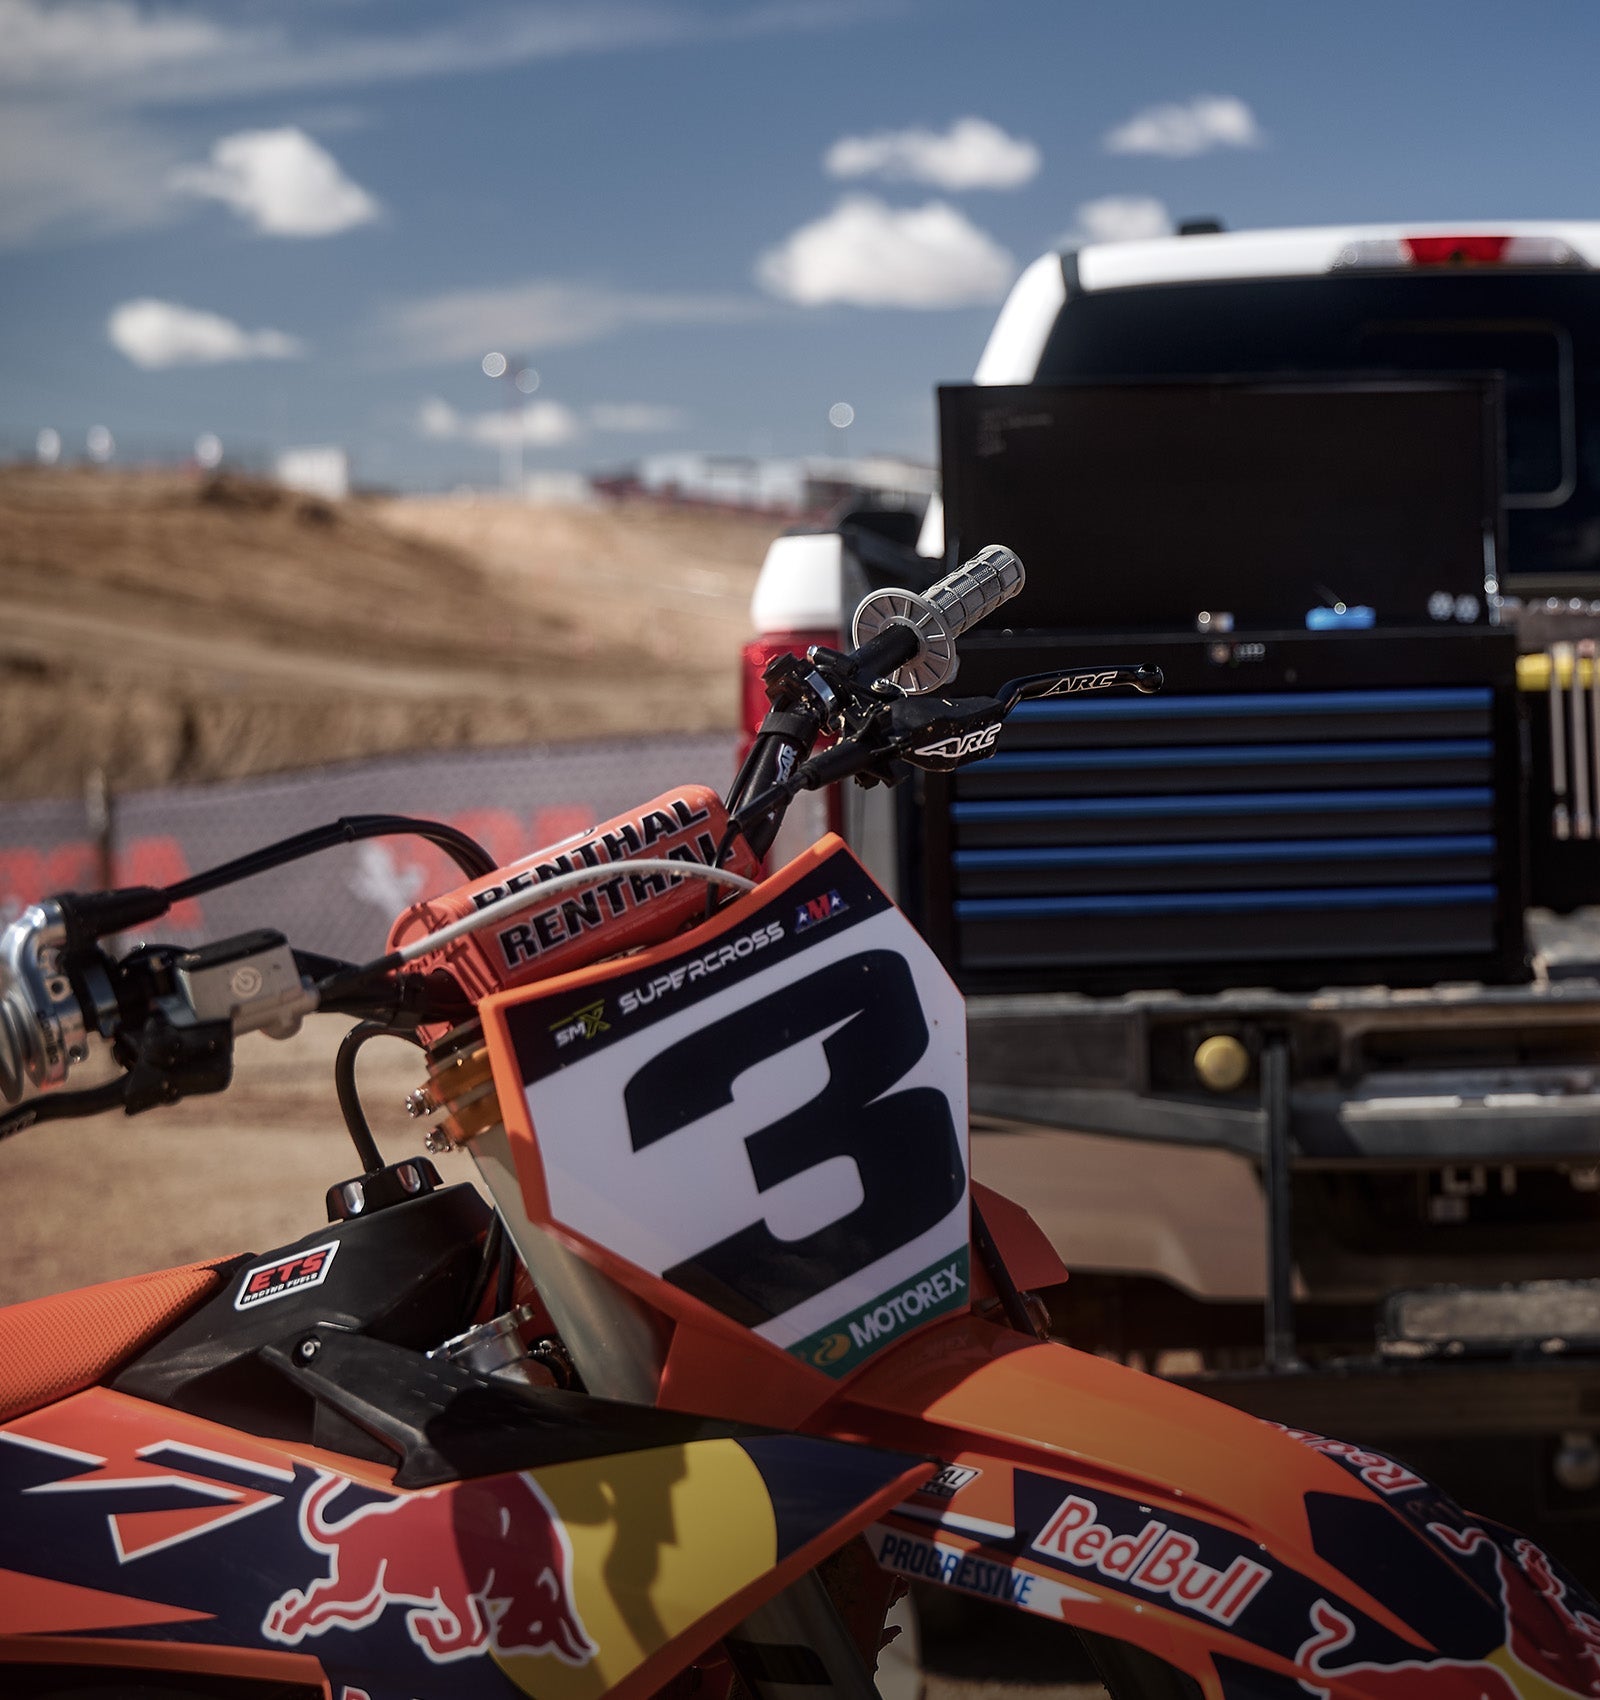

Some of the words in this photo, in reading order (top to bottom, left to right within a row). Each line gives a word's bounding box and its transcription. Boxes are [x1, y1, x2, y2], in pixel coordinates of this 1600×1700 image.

[1041, 671, 1118, 696] ARC
[914, 723, 1002, 758] ARC
[618, 920, 786, 1015] SUPERCROSS
[795, 889, 848, 932] AMA
[623, 948, 966, 1329] 3
[243, 1283, 285, 1303] RACING
[286, 1272, 319, 1288] FUELS
[249, 1250, 328, 1293] ETS
[848, 1262, 967, 1348] MOTOREX
[879, 1532, 1036, 1605] PROGRESSIVE
